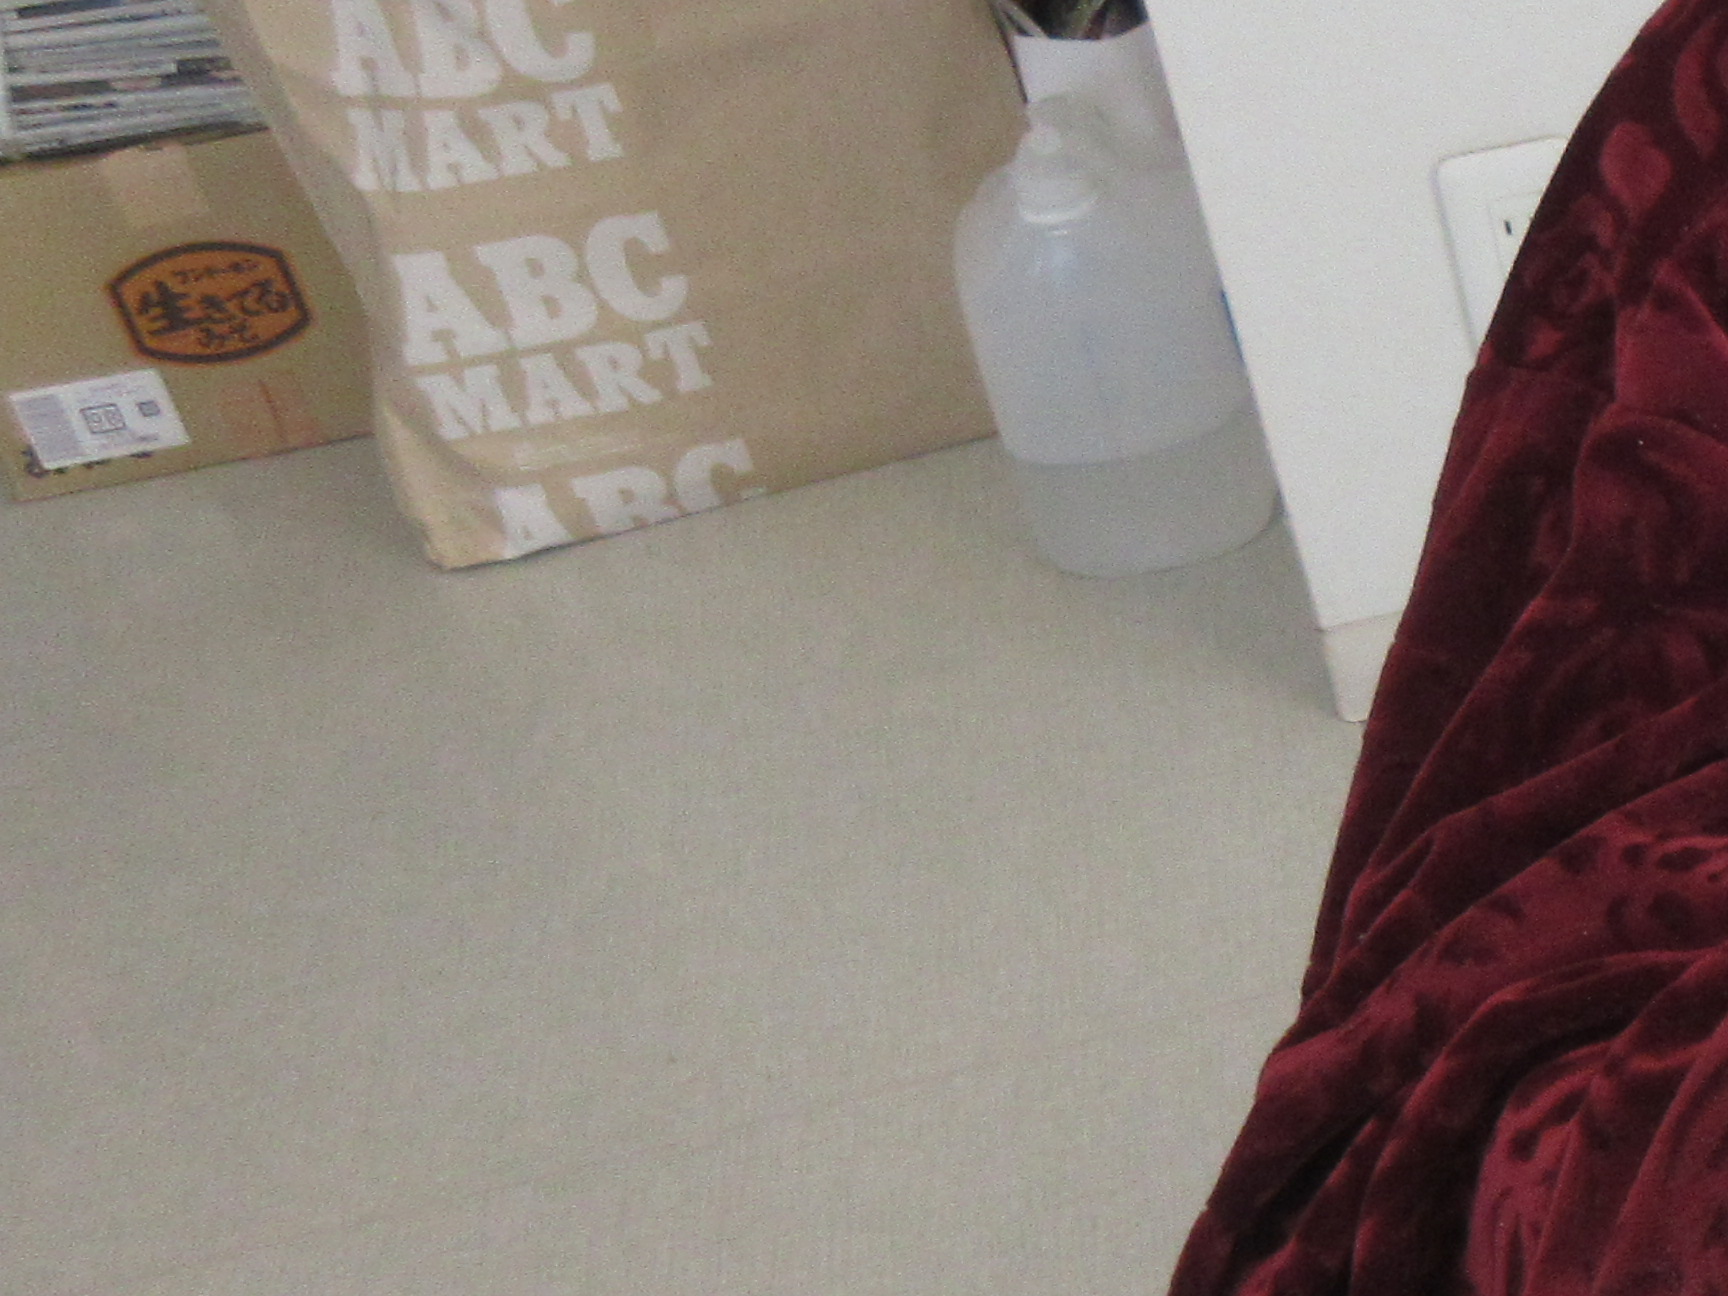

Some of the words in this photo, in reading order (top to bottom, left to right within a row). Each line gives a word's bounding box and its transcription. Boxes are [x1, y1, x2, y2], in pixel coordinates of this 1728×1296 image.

[346, 82, 624, 192] MART
[392, 211, 690, 365] ABC
[413, 320, 714, 440] MART
